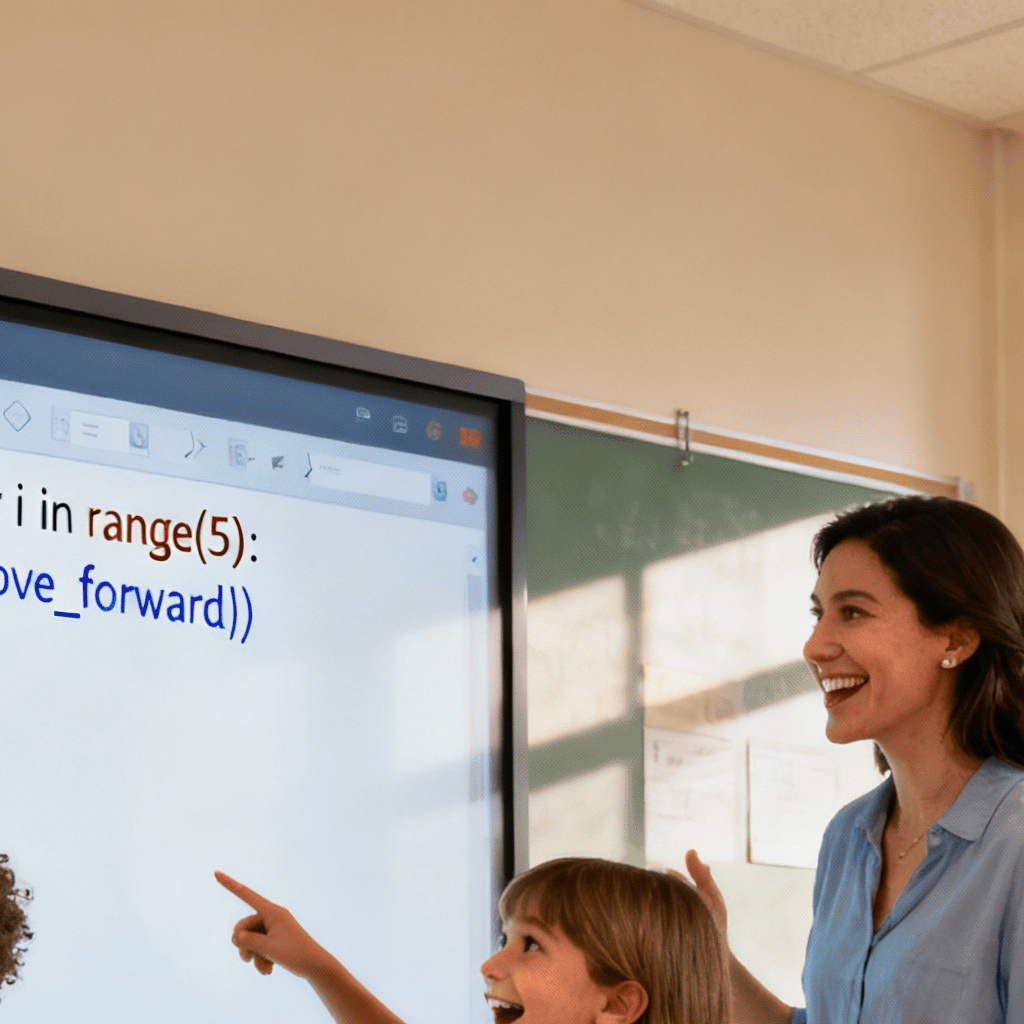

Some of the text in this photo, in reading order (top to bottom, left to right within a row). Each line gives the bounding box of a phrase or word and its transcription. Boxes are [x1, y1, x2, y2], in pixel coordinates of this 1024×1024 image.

[17, 483, 23, 527] i
[41, 487, 73, 534] in
[88, 508, 259, 568] range(5):
